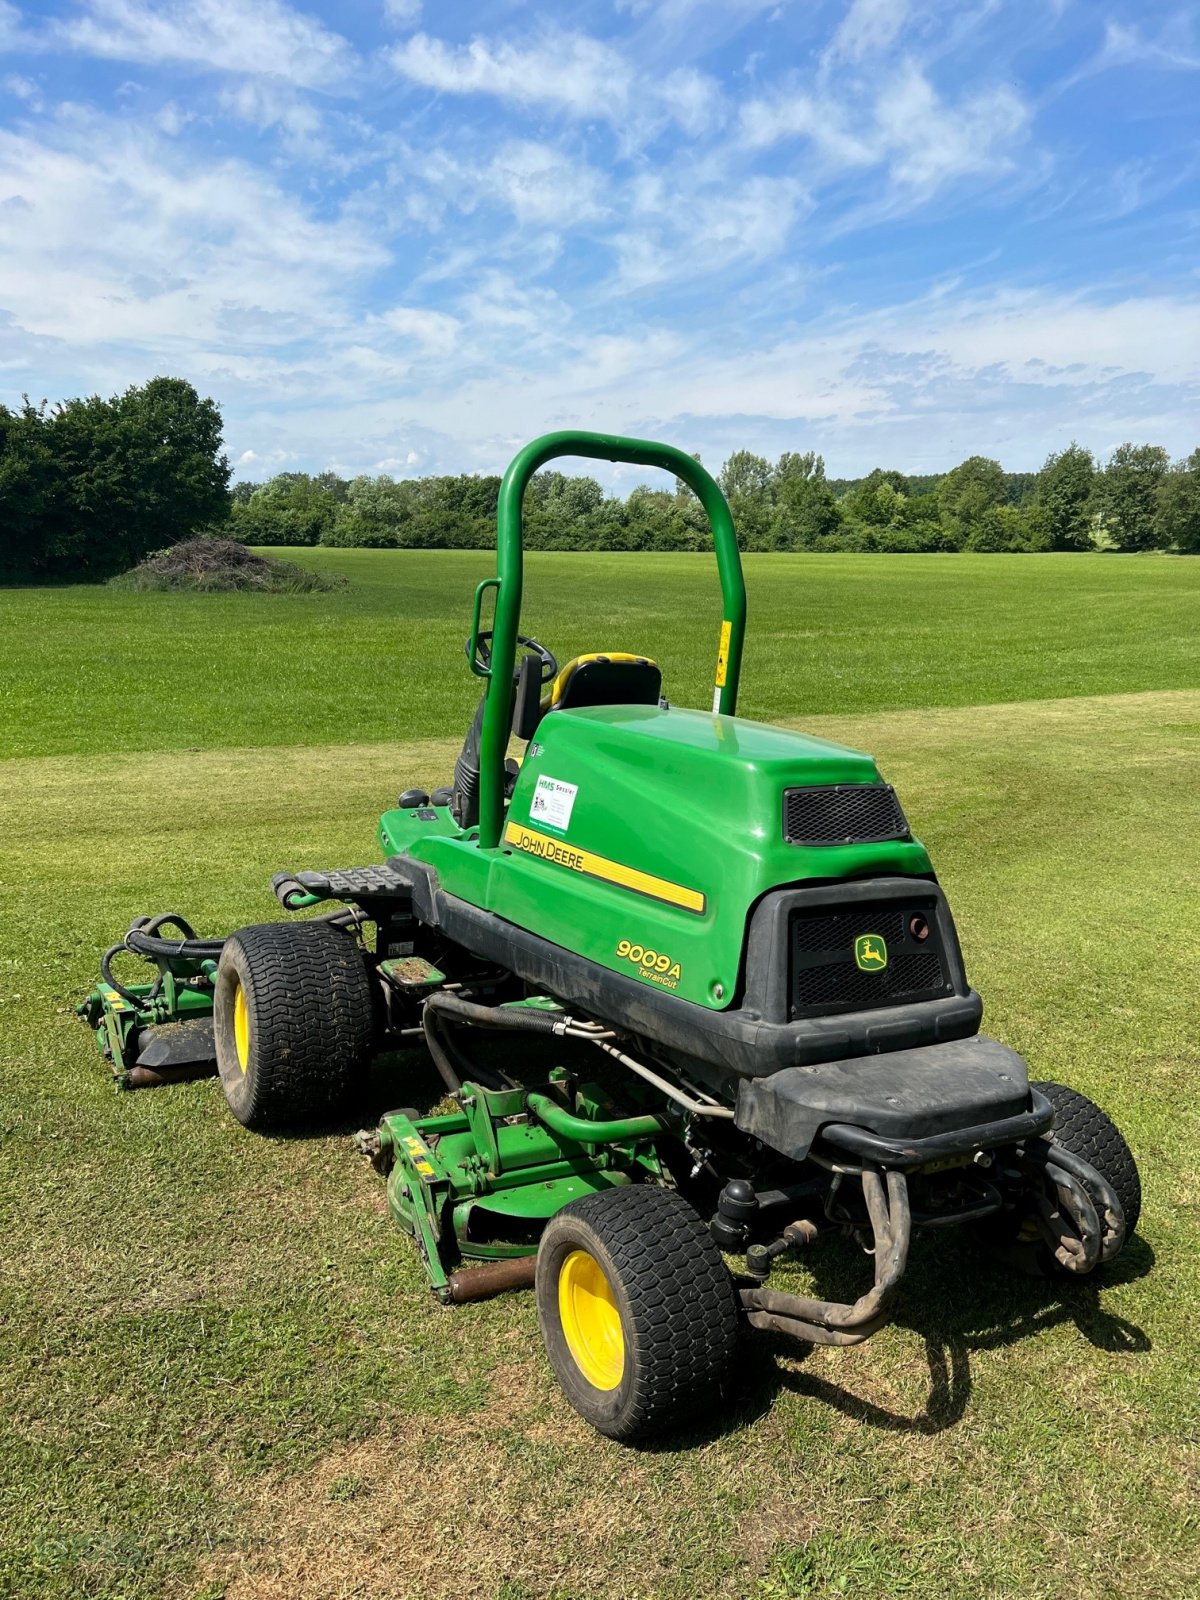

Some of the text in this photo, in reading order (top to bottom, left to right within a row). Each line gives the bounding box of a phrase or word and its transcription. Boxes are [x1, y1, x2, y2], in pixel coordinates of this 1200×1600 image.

[539, 779, 555, 791] HMS
[516, 832, 584, 869] JOHN DEERE
[616, 940, 681, 979] 9009A
[639, 967, 678, 989] TerrainCut
